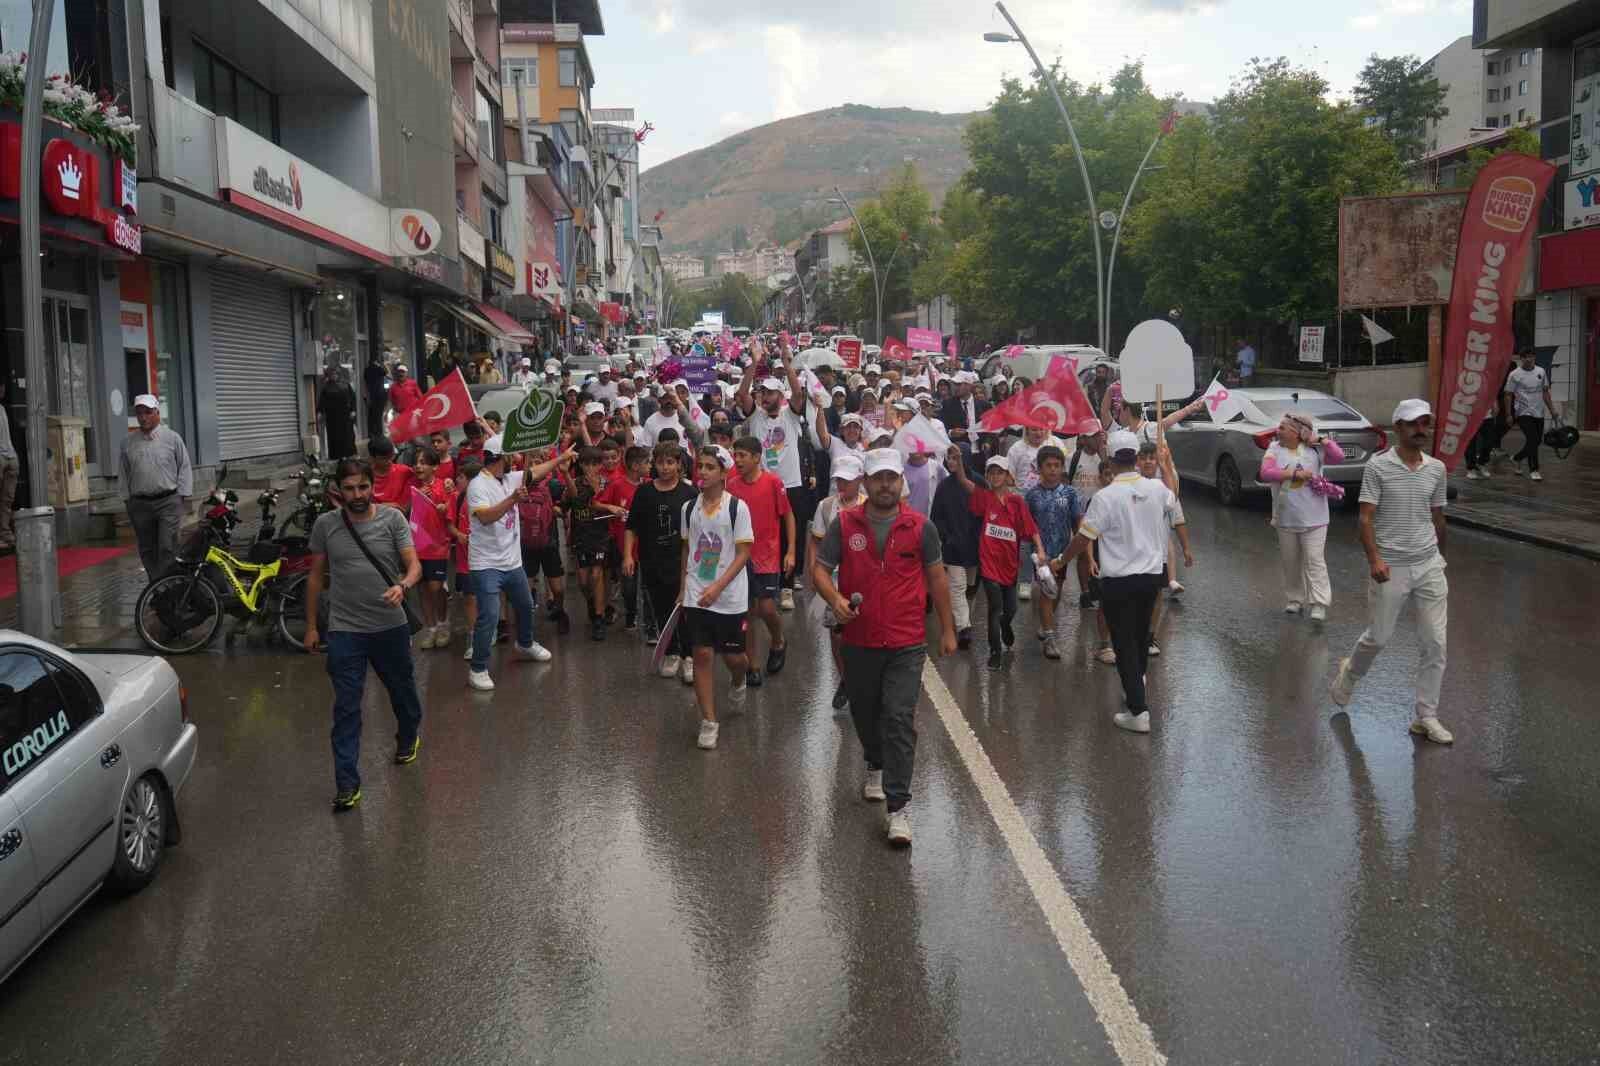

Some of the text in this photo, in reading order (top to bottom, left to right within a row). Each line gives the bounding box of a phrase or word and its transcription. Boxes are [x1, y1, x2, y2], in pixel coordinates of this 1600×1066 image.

[1485, 200, 1529, 222] KING
[1489, 190, 1533, 207] BURGER
[1439, 240, 1506, 455] BURGER KING
[3, 709, 70, 776] COROLLA
